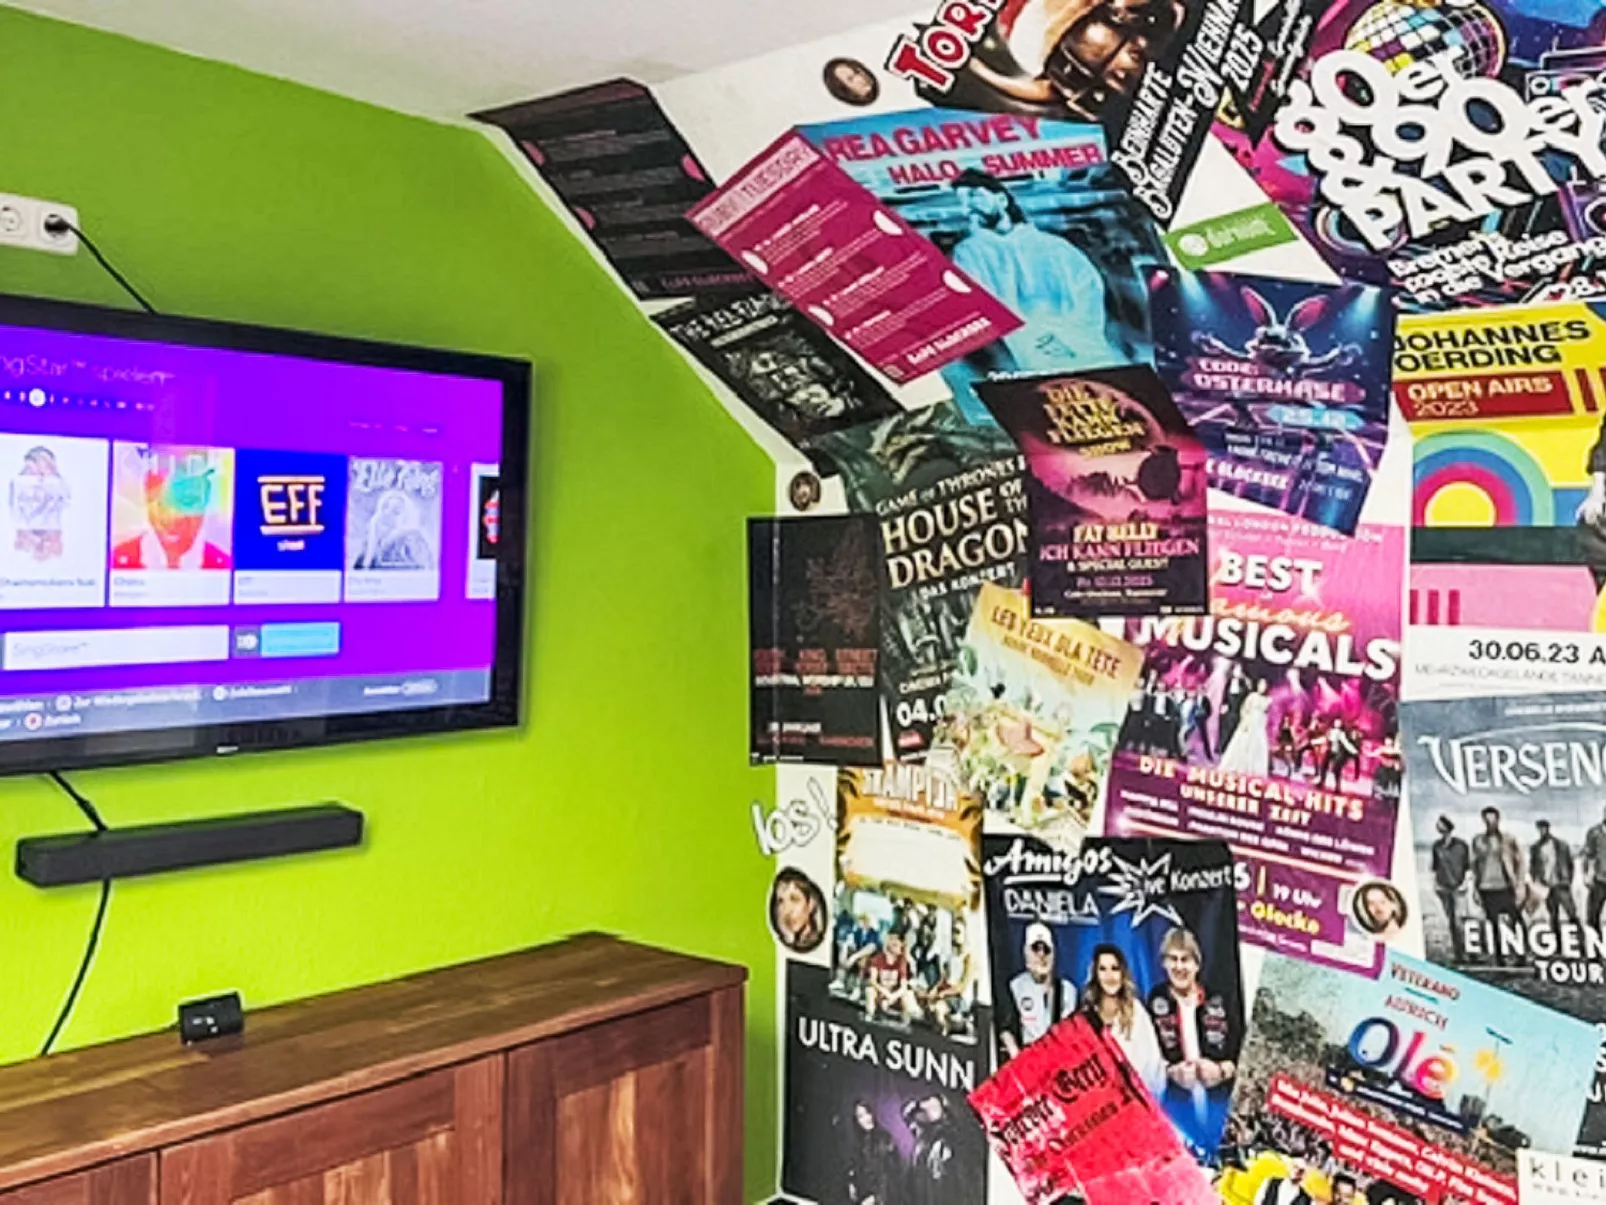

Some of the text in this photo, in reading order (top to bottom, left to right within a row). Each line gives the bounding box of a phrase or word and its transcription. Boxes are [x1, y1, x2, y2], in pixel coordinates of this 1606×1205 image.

[886, 0, 1000, 92] TOR
[1221, 23, 1263, 92] 2025
[892, 112, 1041, 157] GARVEY
[888, 143, 1104, 186] HALO SUMMER
[1395, 320, 1590, 350] JOHANNES
[1395, 345, 1562, 372] OERDING
[1194, 373, 1346, 402] OSTERHASE
[1407, 376, 1553, 400] OPEN AIRS
[1413, 401, 1479, 417] 2023
[261, 484, 325, 525] EFF
[876, 488, 918, 516] GAME
[880, 487, 997, 554] HOUSE
[1073, 525, 1104, 543] FAT
[1040, 543, 1069, 561] ICH
[1217, 551, 1323, 595] BEST
[991, 605, 1017, 631] LES
[1210, 597, 1351, 631] amous
[1133, 613, 1402, 680] MUSICALS
[1469, 640, 1580, 664] 30.06.23
[1139, 755, 1177, 778] DIE
[1417, 735, 1606, 795] VERSEN
[751, 776, 838, 856] los!
[1269, 803, 1312, 826] ZEIT
[983, 838, 1113, 886] Amigos
[1170, 866, 1233, 893] Konzert
[1004, 889, 1100, 917] DANIELA
[1273, 883, 1289, 901] 19
[1292, 888, 1323, 909] Uhr
[1250, 904, 1321, 935] Glocke
[1389, 962, 1461, 1001] VETERANO
[1535, 960, 1604, 984] TOUR
[799, 1016, 974, 1094] ULTRA SUNN
[1348, 1016, 1459, 1099] Olé
